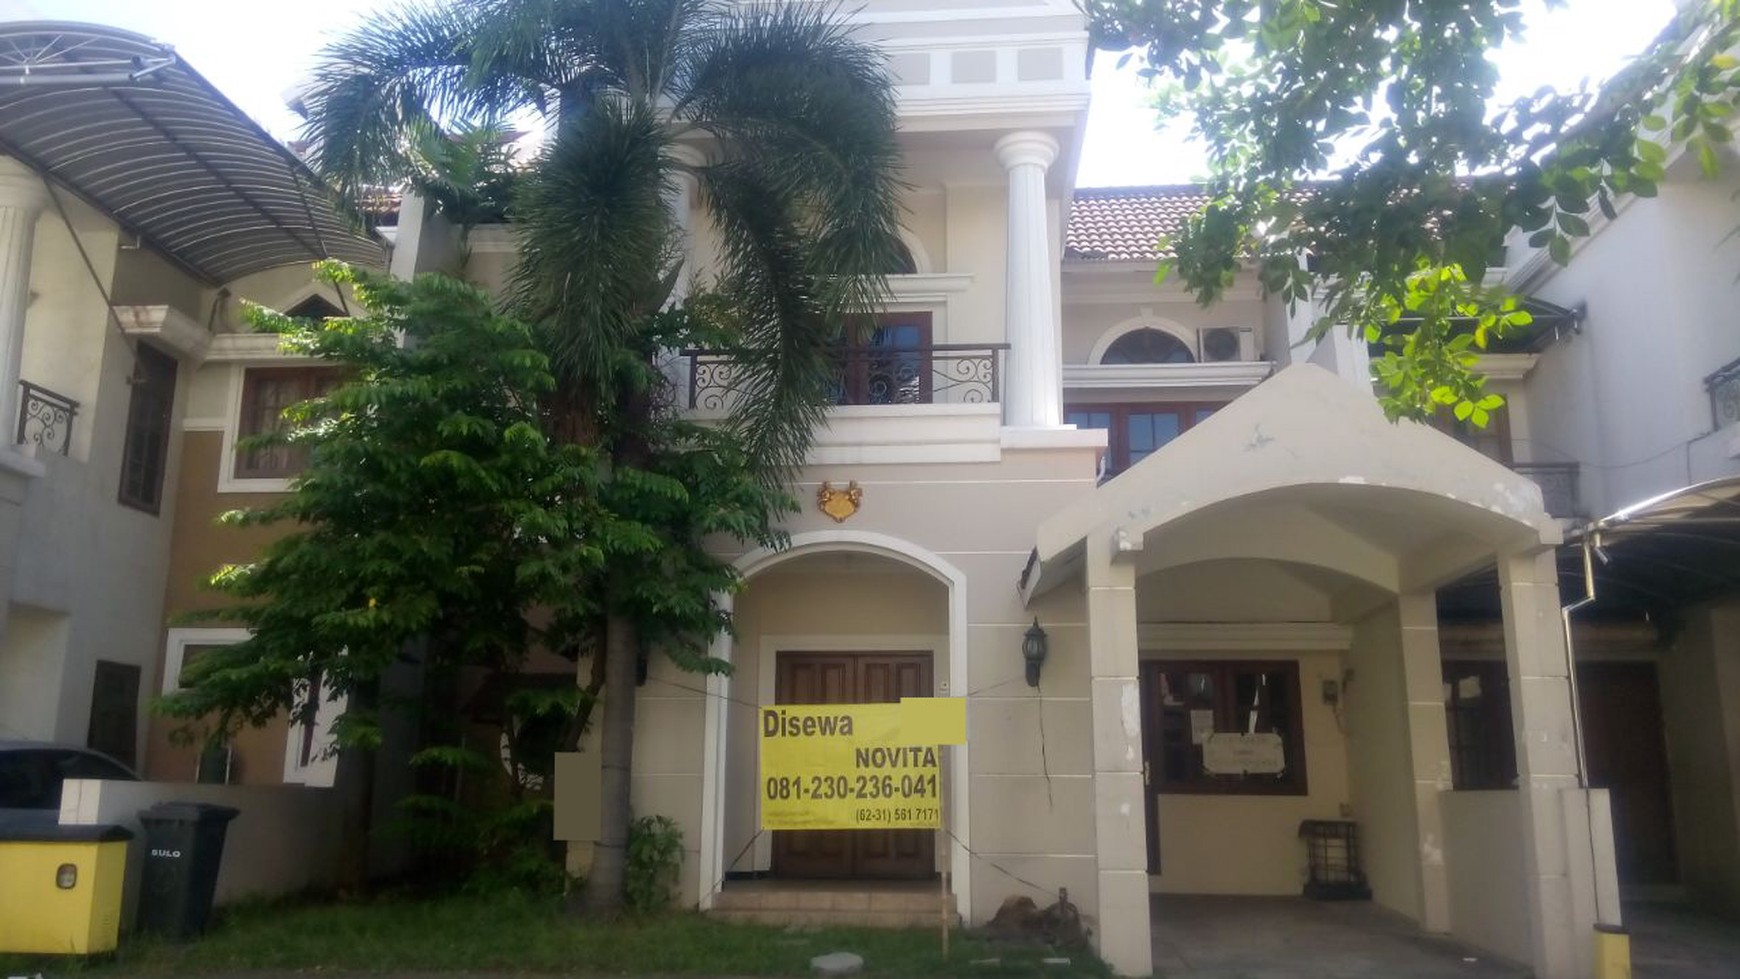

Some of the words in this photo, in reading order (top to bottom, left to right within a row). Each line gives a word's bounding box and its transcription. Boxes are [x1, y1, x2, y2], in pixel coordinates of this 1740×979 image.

[763, 710, 853, 737] Disewa
[856, 747, 937, 768] NOVITA
[767, 774, 937, 800] 081-230-236-041
[855, 809, 892, 824] (62-31)
[894, 808, 912, 822] 561
[915, 808, 938, 821] 7171
